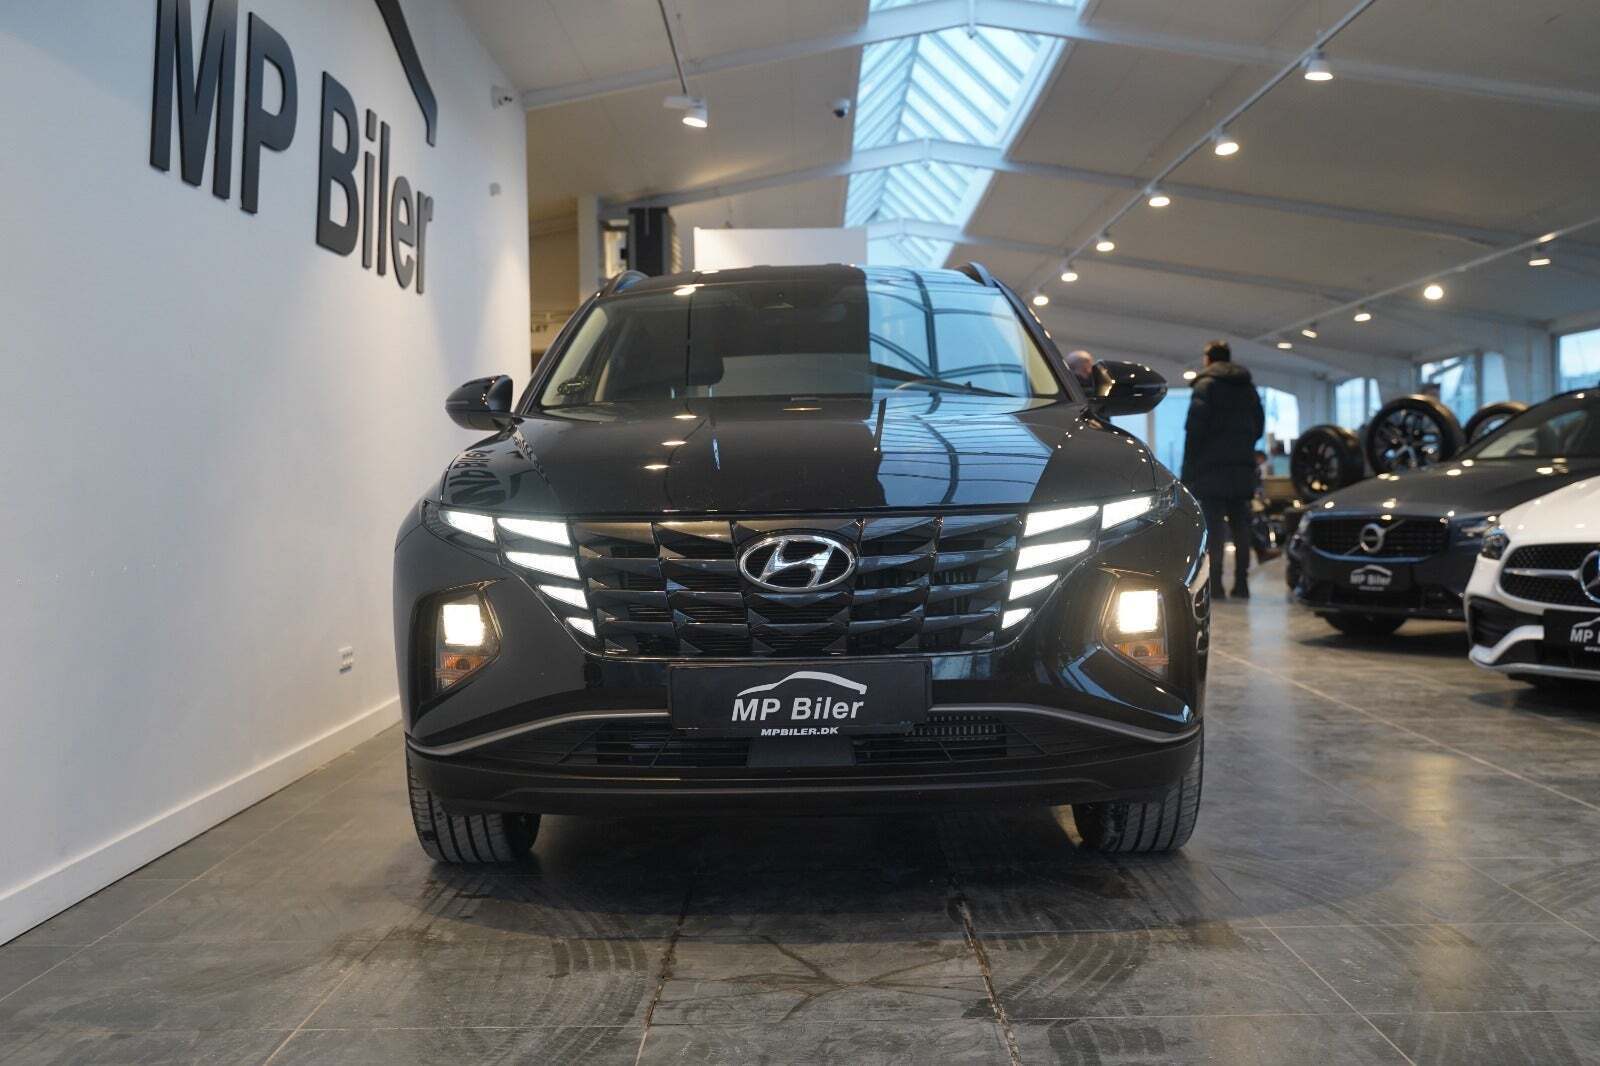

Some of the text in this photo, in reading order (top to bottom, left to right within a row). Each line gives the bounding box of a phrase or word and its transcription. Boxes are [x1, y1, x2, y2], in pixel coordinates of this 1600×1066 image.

[150, 0, 434, 294] MP Biler
[1570, 628, 1594, 643] MP
[731, 697, 864, 721] MP Biler
[760, 726, 839, 736] MPBILER.DK
